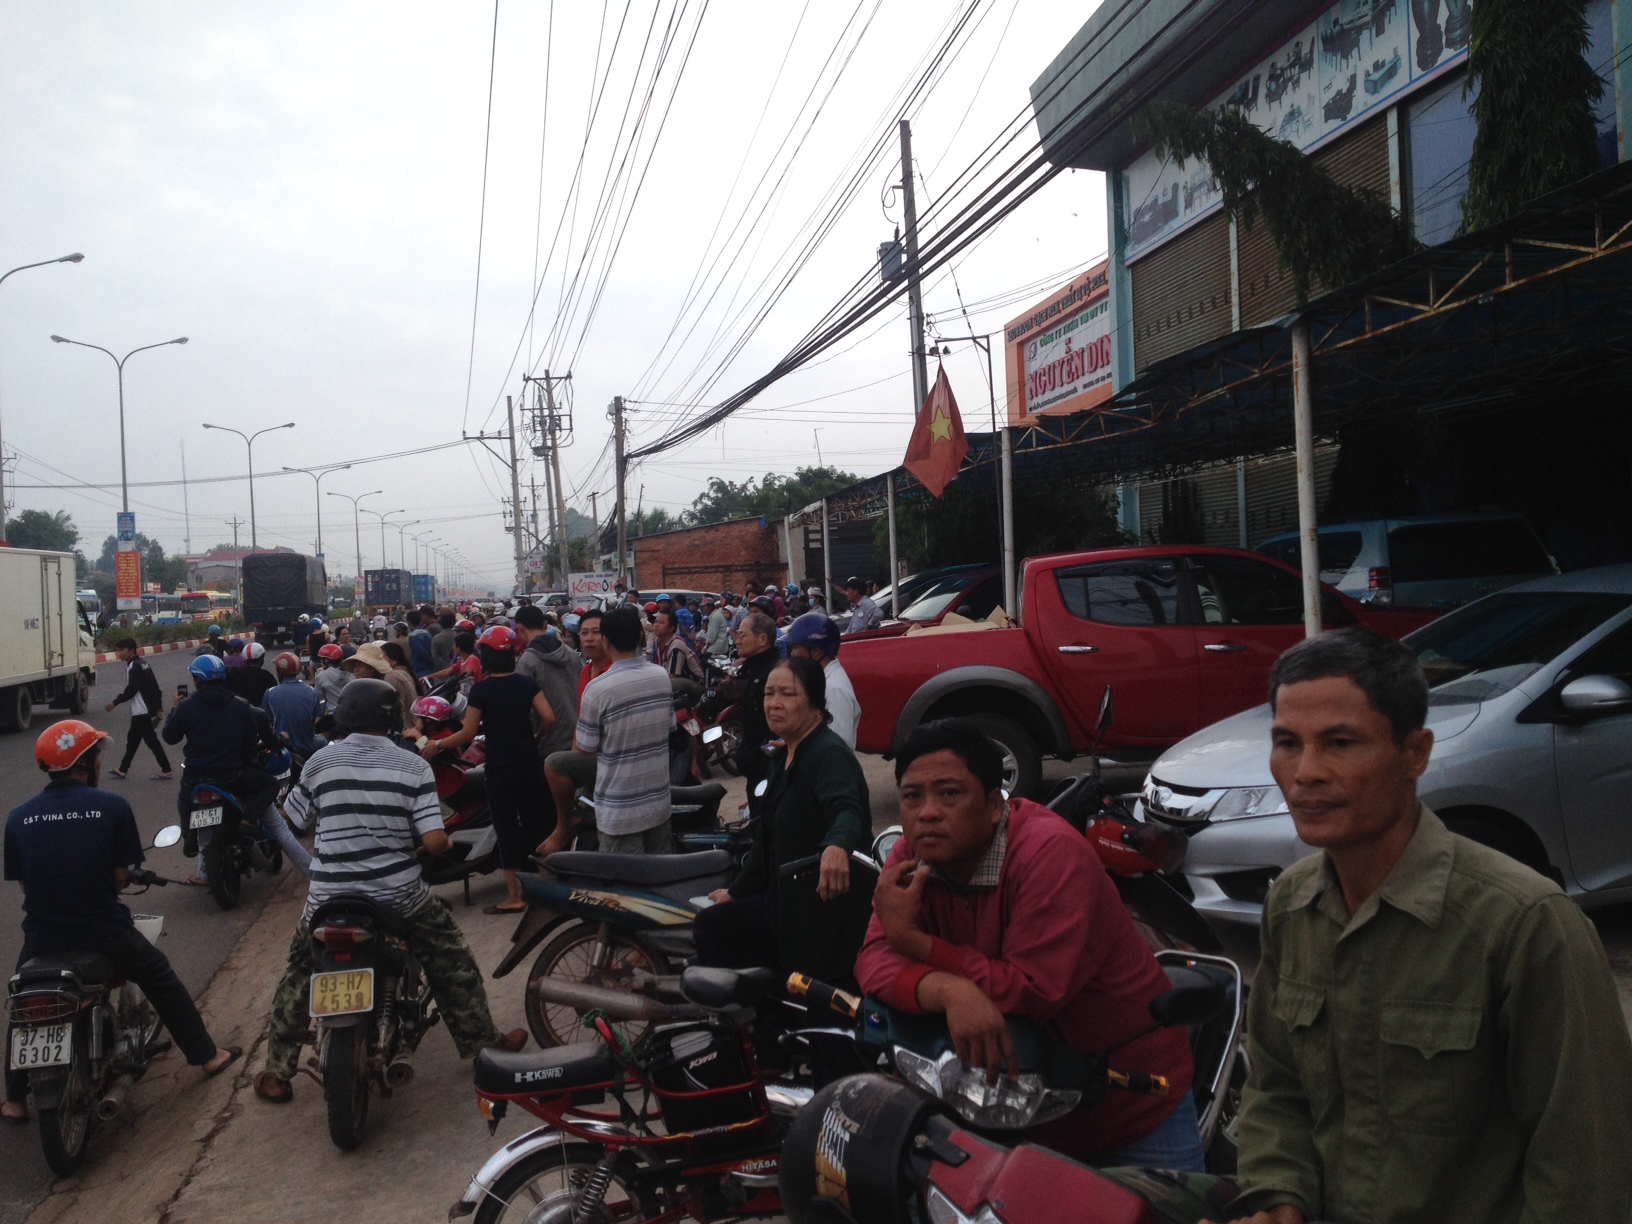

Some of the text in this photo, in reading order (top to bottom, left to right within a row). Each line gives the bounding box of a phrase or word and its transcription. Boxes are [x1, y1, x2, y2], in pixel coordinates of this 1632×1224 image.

[1028, 337, 1085, 400] NGUYỄN
[23, 815, 39, 825] C&T
[42, 813, 63, 821] VINA
[320, 973, 364, 993] 93-H7
[19, 1045, 62, 1065] 6302
[742, 1160, 777, 1172] HITASA
